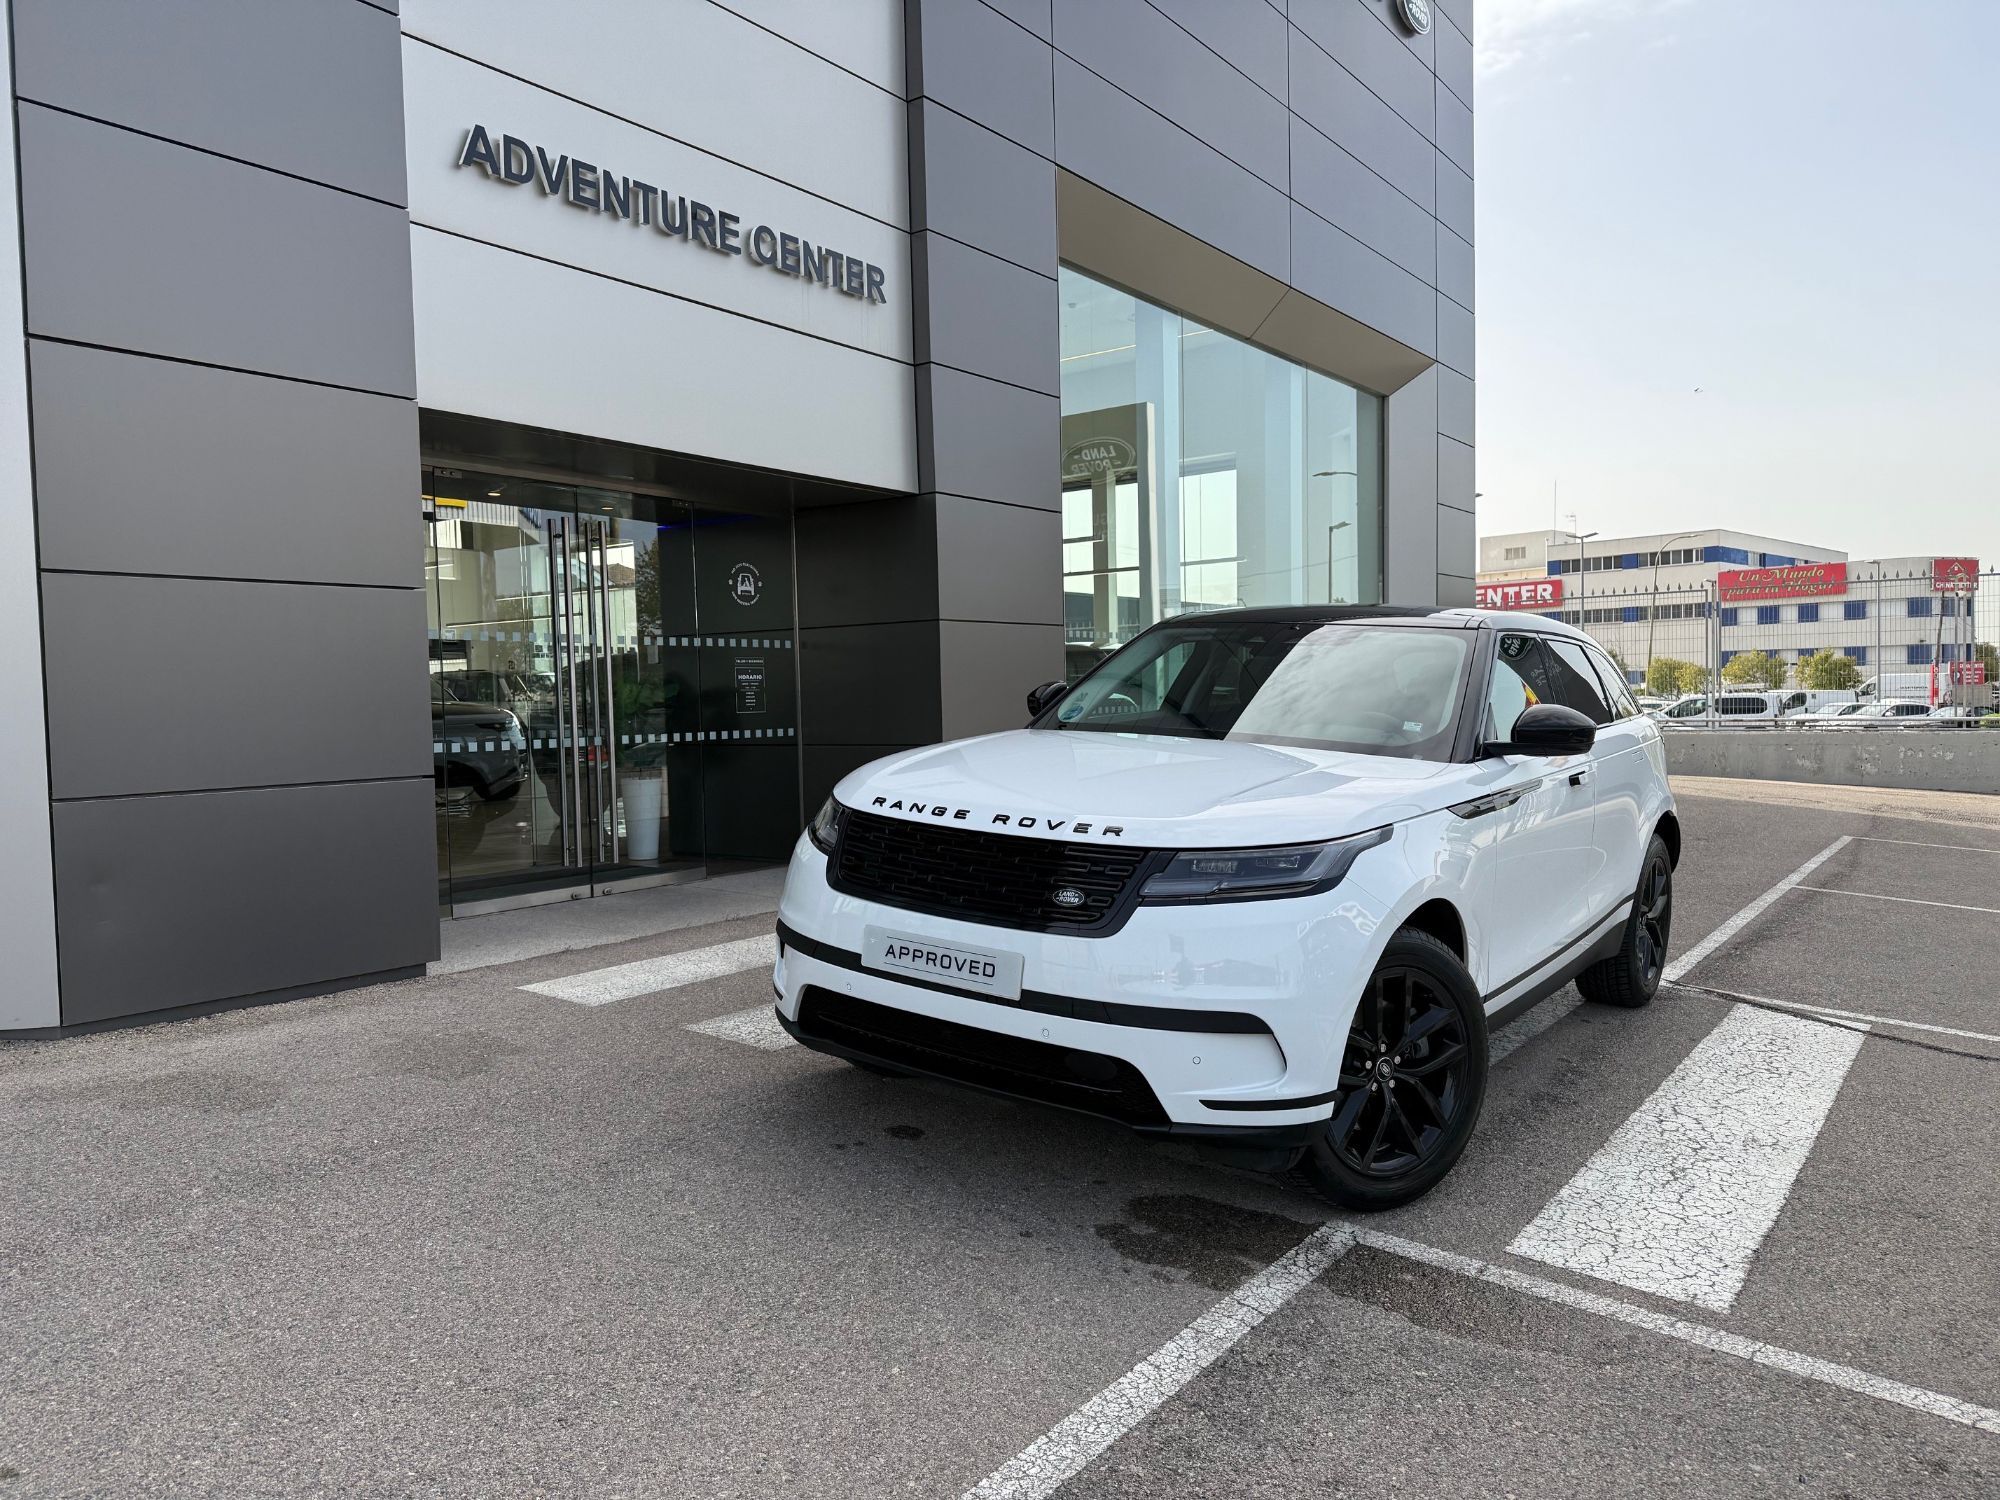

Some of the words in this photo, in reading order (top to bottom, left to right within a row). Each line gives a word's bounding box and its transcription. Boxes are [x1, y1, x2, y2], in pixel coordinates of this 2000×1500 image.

[459, 124, 742, 255] ADVENTURE
[749, 225, 887, 304] CENTER
[1762, 567, 1825, 582] Mundo
[872, 796, 971, 820] RANGE
[992, 814, 1124, 837] ROVER
[885, 944, 996, 978] APPROVED
